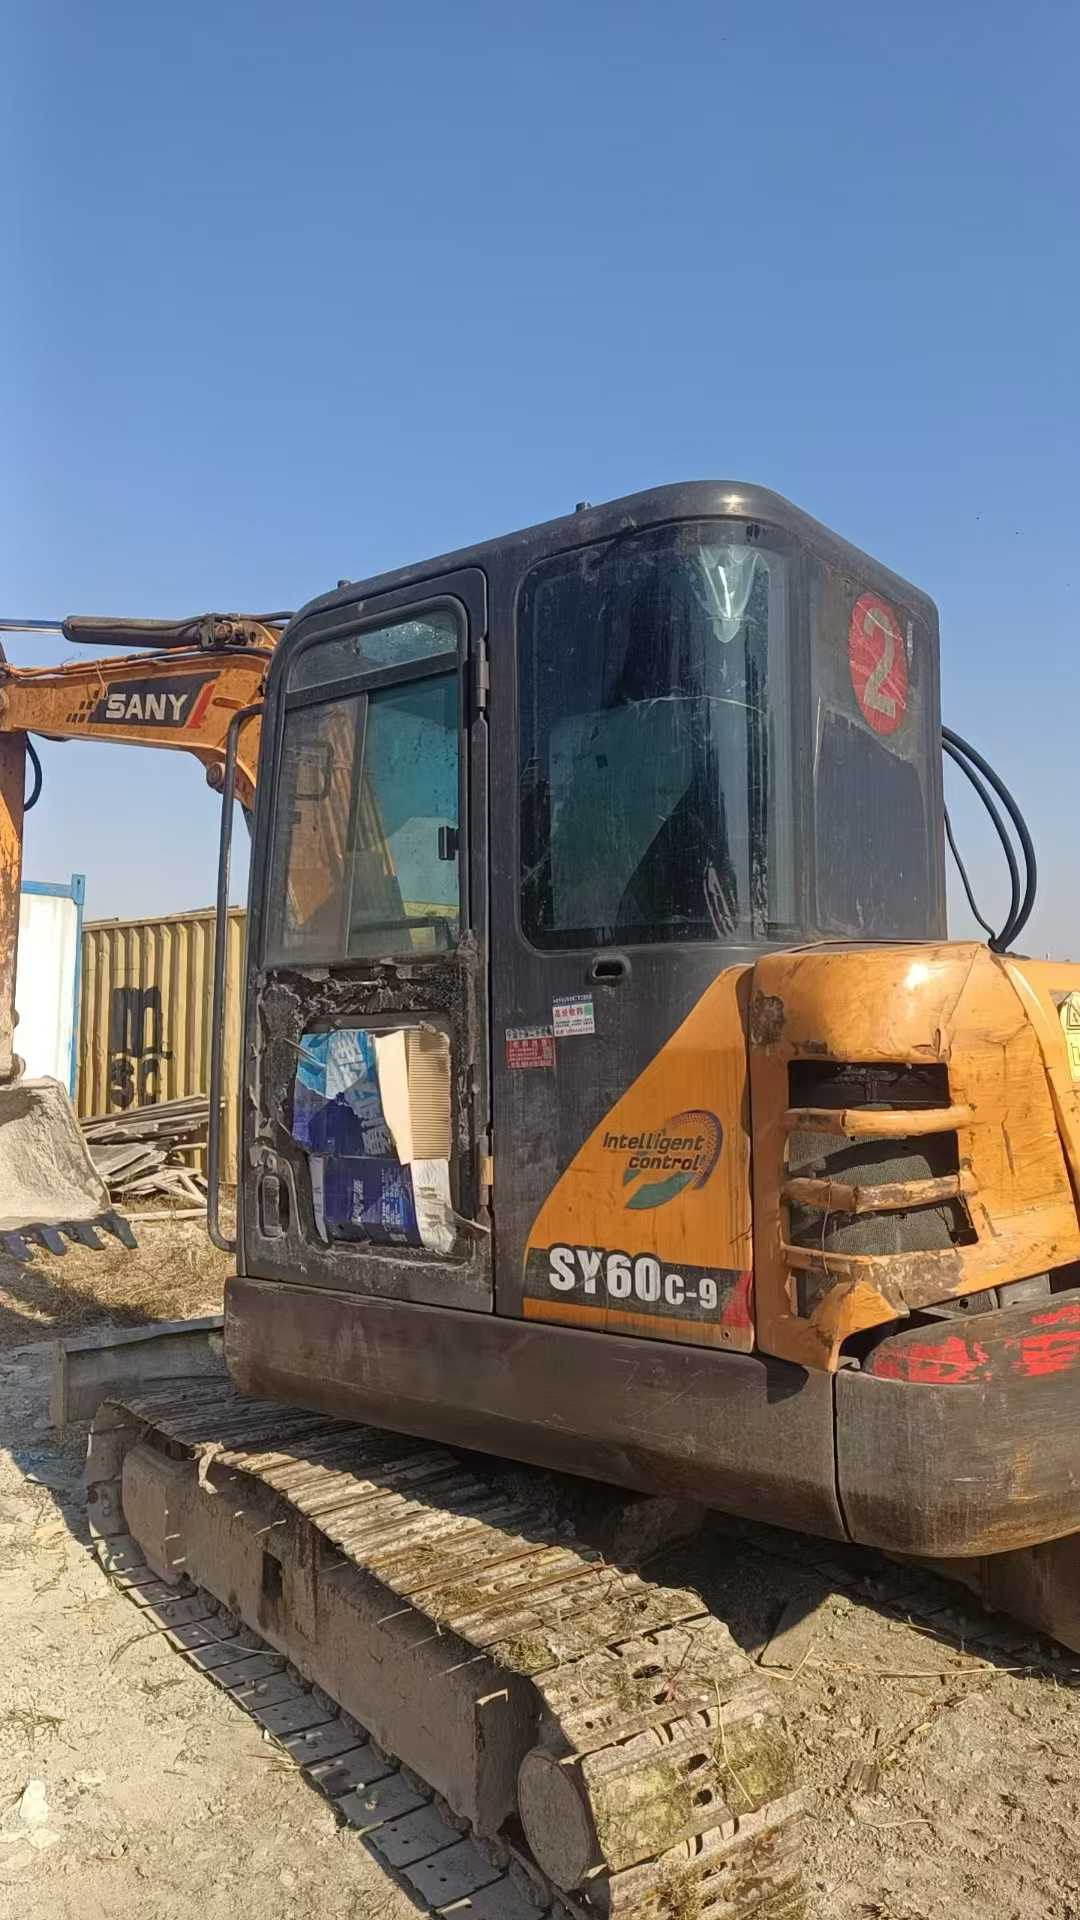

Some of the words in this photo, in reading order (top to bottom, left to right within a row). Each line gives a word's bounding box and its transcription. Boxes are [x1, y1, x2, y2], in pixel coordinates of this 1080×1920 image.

[863, 607, 896, 719] 2
[105, 693, 188, 720] SANY
[603, 1131, 705, 1153] Intelligent
[628, 1154, 701, 1170] control
